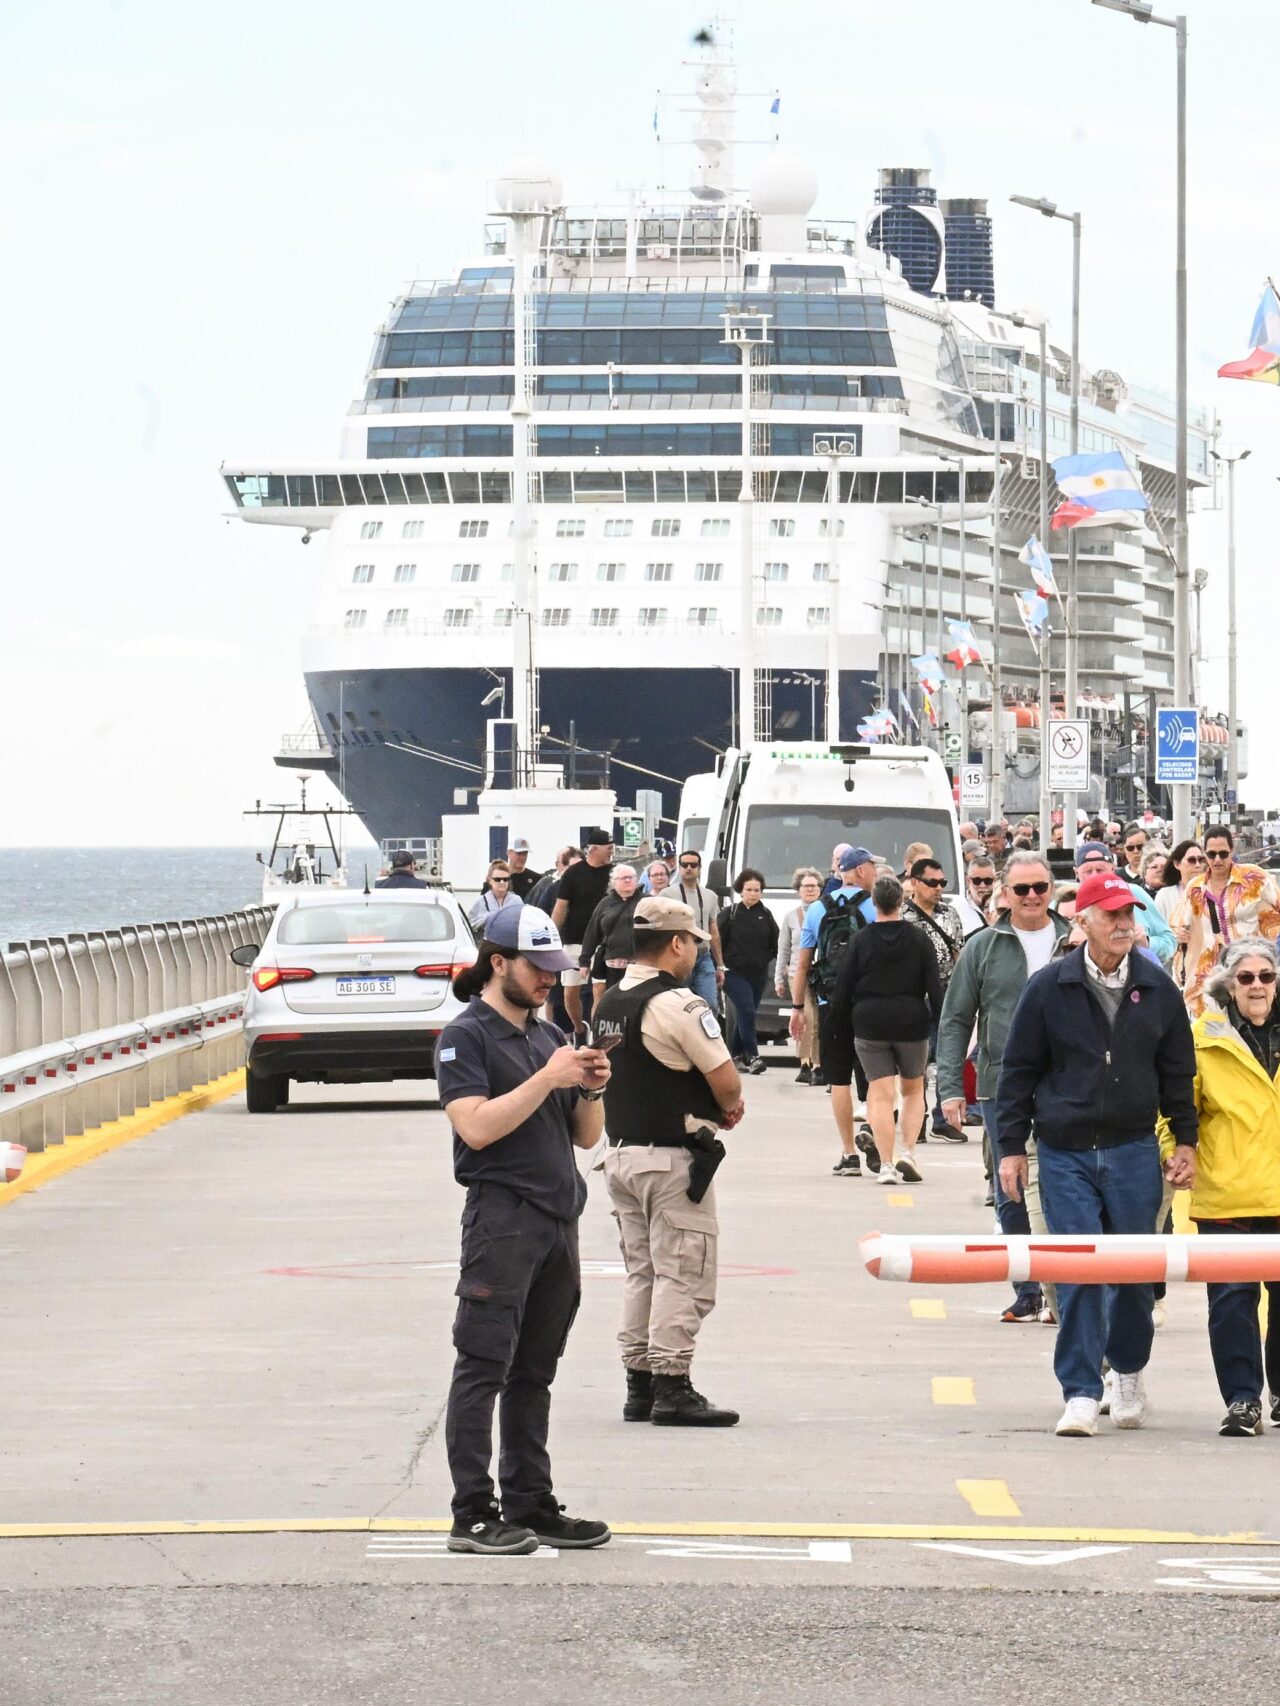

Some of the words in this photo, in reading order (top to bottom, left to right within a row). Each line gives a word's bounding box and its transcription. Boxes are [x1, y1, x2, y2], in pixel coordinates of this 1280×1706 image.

[968, 774, 980, 784] 15
[339, 982, 352, 992] AG
[356, 982, 376, 992] 300
[380, 981, 392, 992] SE
